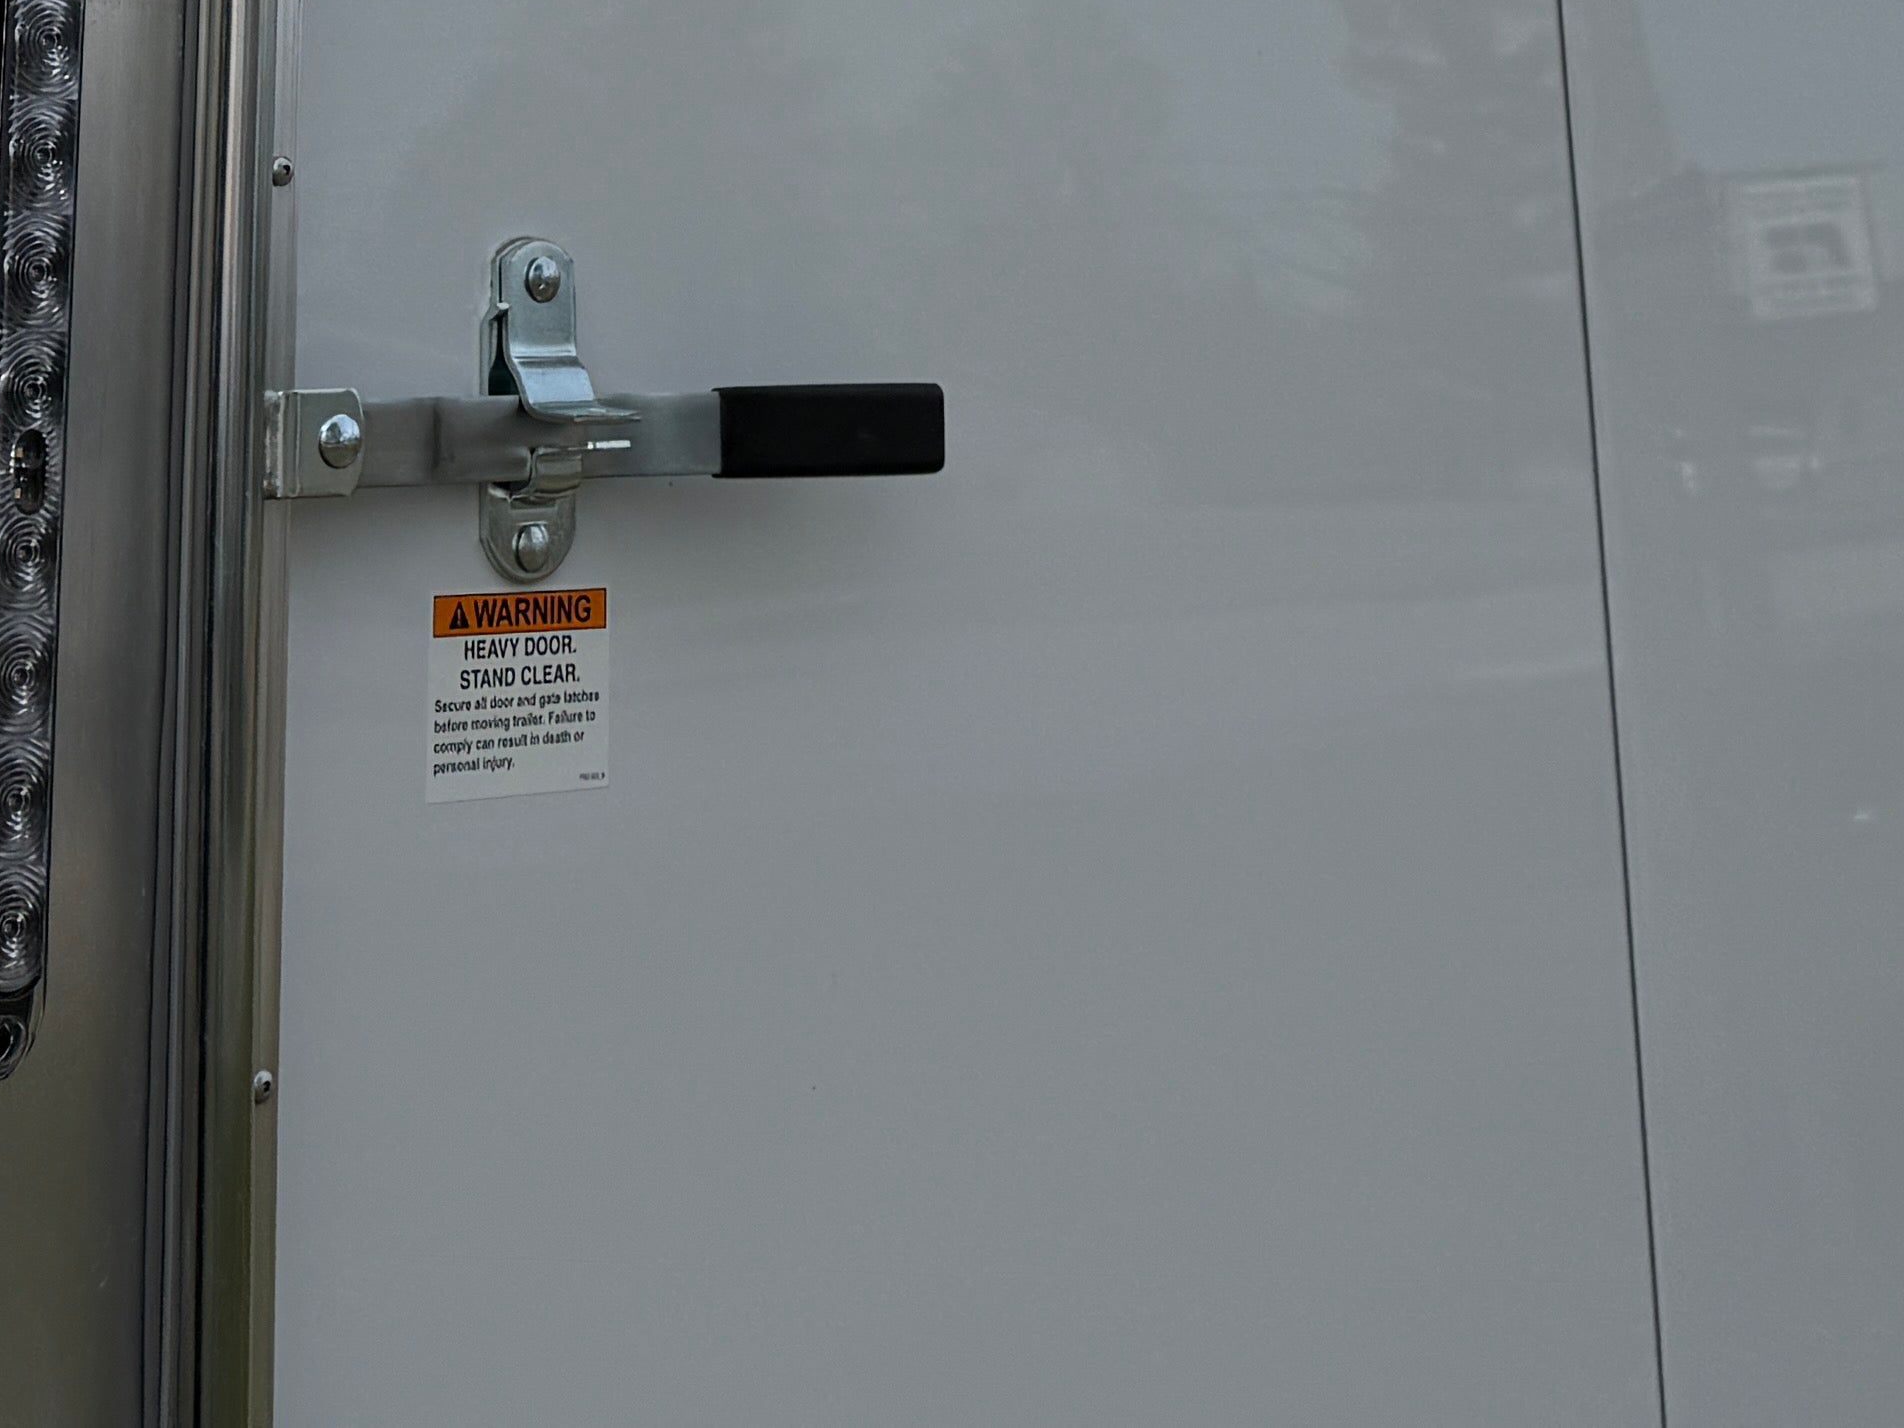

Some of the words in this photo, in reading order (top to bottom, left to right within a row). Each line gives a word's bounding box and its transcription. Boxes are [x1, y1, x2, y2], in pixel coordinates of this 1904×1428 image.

[473, 594, 592, 629] WARNING
[464, 637, 520, 661] HEAVY
[524, 635, 577, 657] DOOR.
[459, 667, 516, 690] STAND
[521, 663, 580, 685] CLEAR.
[434, 699, 472, 713] Secure
[474, 696, 487, 710] all
[490, 695, 514, 709] door
[517, 693, 536, 706] and
[539, 694, 561, 708] gate
[563, 690, 600, 704] latches
[434, 718, 469, 733] before
[471, 715, 510, 731] moving
[512, 712, 545, 727] trailer.
[548, 710, 583, 725] Failure
[585, 709, 596, 722] to
[433, 737, 472, 755] comply
[476, 740, 495, 751] can
[497, 734, 527, 748] result
[529, 731, 540, 745] in
[542, 730, 571, 745] death
[573, 731, 585, 743] or
[433, 757, 480, 777] personal
[482, 755, 515, 773] injury.
